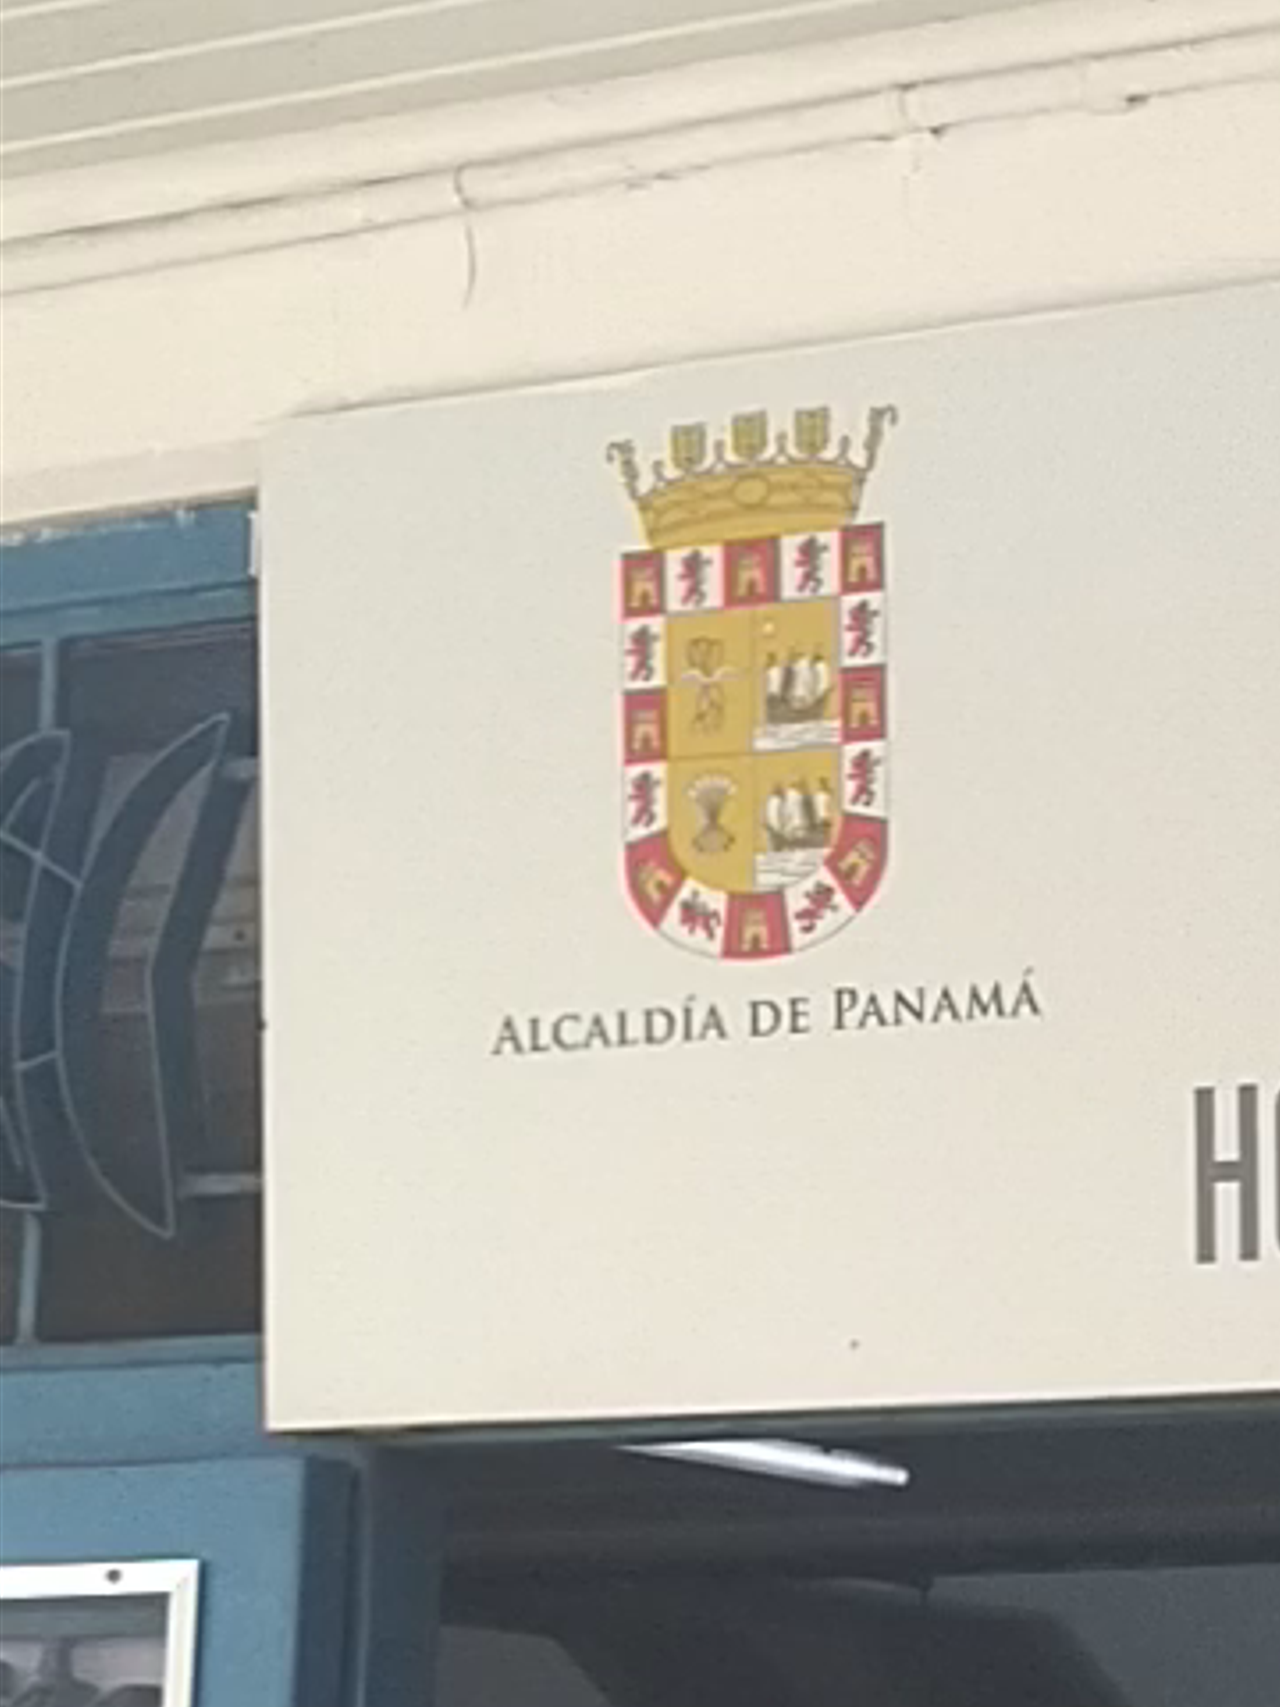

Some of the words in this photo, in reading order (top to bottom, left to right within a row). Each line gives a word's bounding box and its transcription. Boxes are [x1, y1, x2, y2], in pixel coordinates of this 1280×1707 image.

[491, 994, 728, 1055] ALCALDÍA
[748, 997, 811, 1038] DE
[832, 968, 1041, 1031] PANAMÁ
